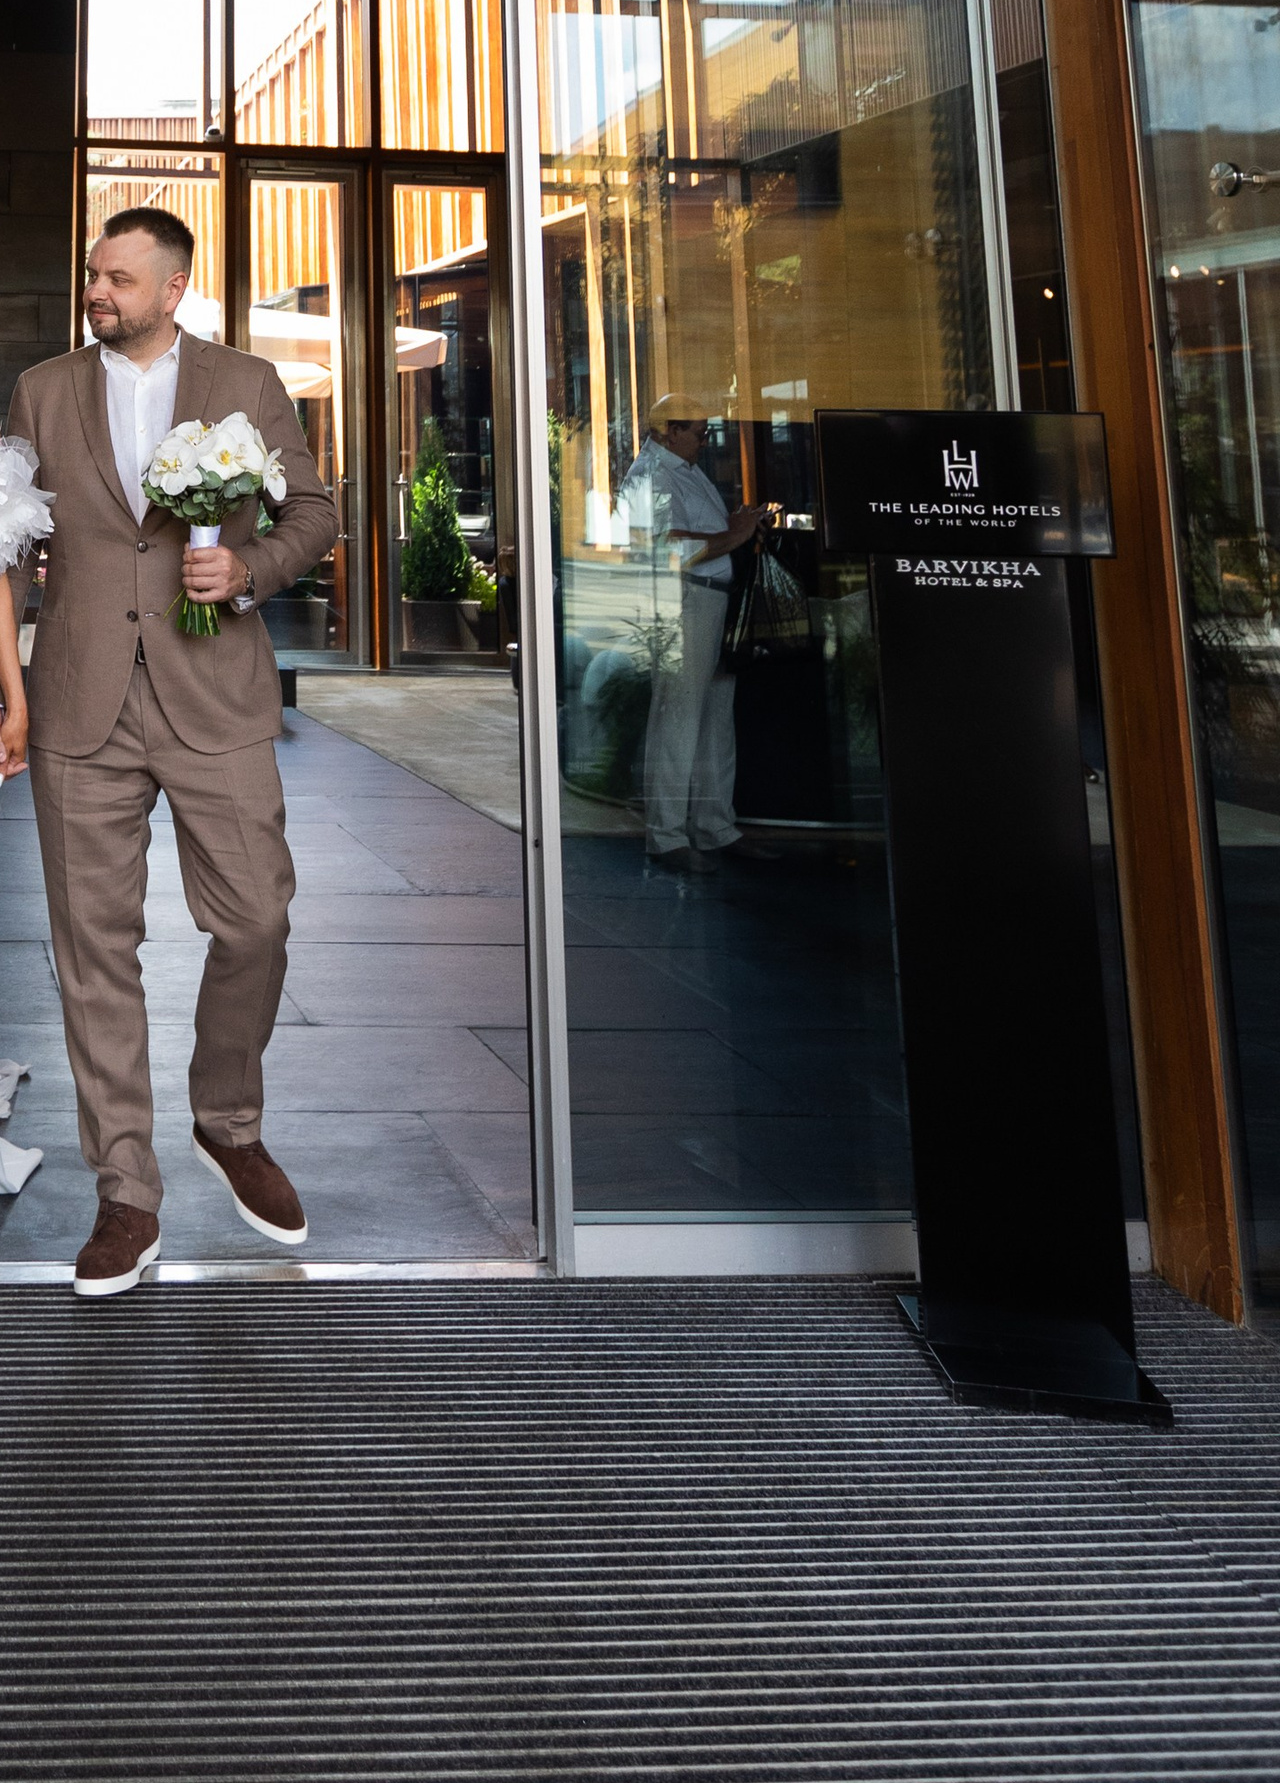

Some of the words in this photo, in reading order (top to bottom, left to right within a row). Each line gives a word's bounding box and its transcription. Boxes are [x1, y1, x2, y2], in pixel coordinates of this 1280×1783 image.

[868, 502, 902, 513] THE
[909, 503, 986, 515] LEADING
[992, 504, 1061, 517] HOTELS
[914, 518, 931, 526] OF
[938, 518, 963, 527] THE
[969, 519, 1016, 529] WORLD
[895, 558, 1042, 577] BARVIKHA
[914, 575, 972, 587] HOTEL
[975, 577, 989, 588] &
[992, 577, 1024, 589] SPA
